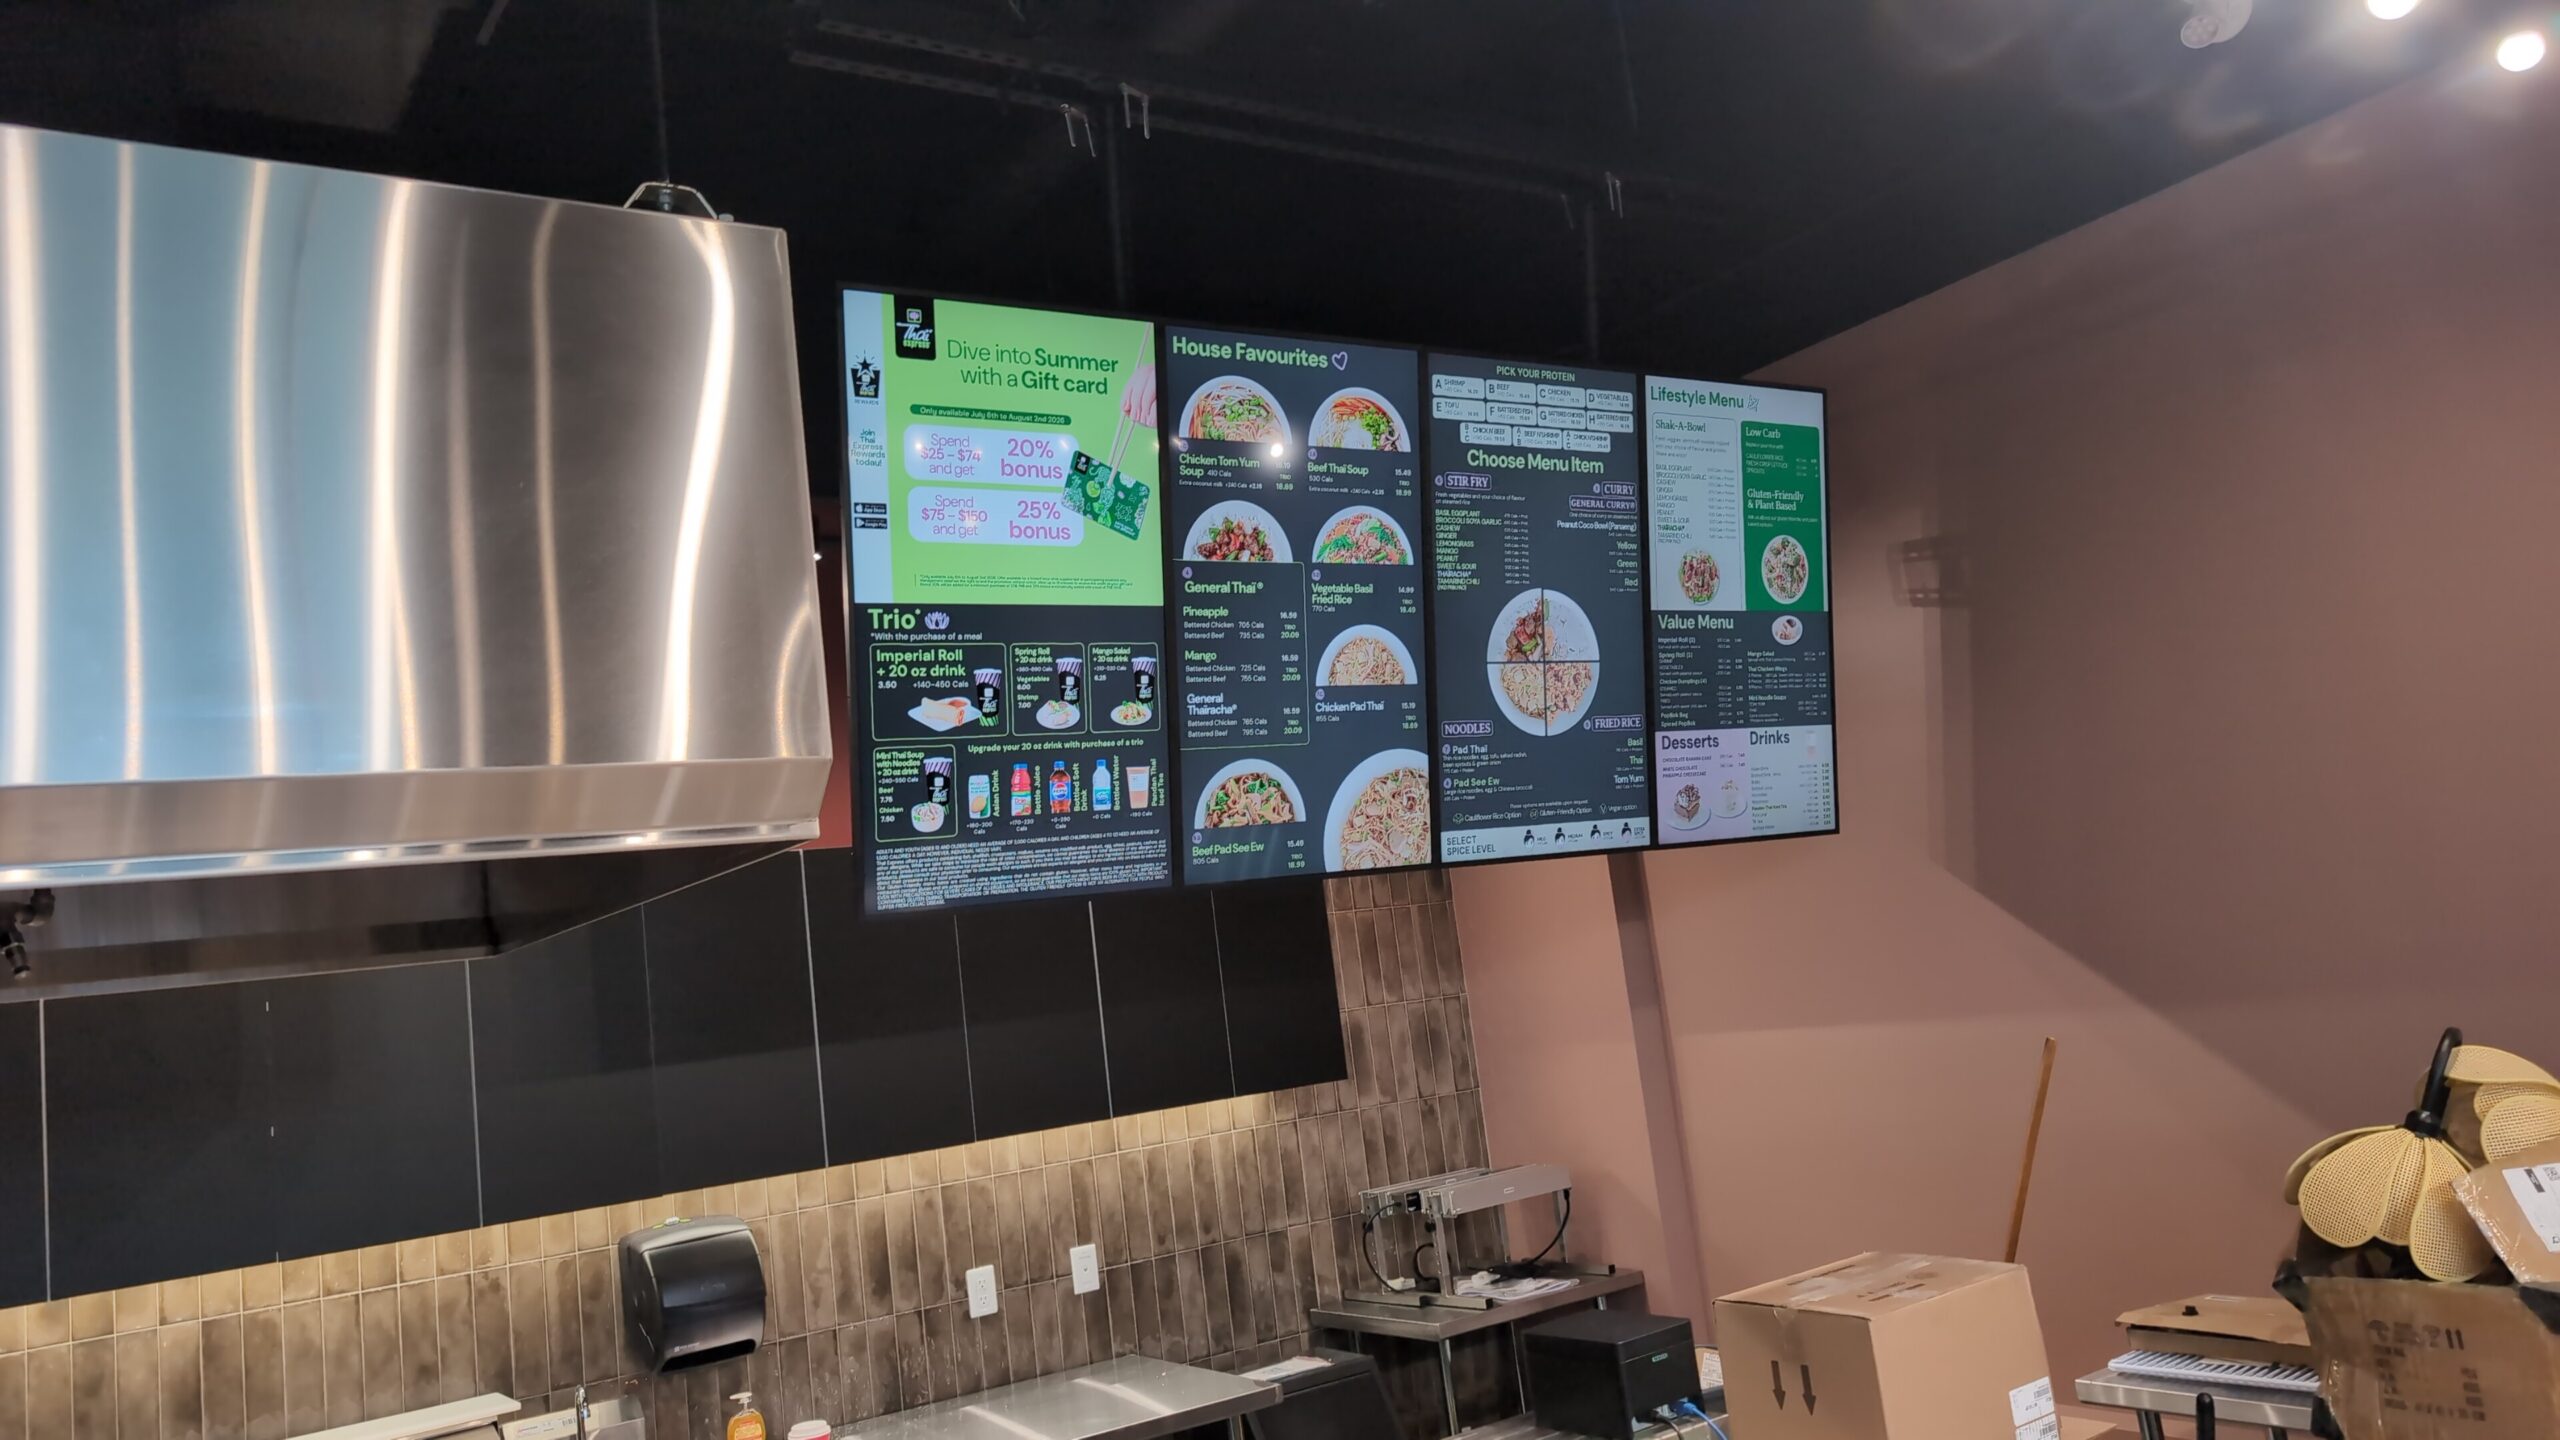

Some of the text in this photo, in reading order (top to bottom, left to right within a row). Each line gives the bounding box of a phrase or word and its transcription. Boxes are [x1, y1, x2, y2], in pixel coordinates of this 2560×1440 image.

[948, 340, 1118, 372] Dive into Summer
[1172, 335, 1328, 369] House Favourites
[1496, 365, 1576, 382] PICK YOUR PROTEIN
[960, 366, 1108, 395] with a Gift card
[1488, 383, 1495, 393] B
[1588, 393, 1629, 402] D VEGETABLES
[1650, 386, 1744, 409] Lifestyle Menu
[920, 406, 937, 416] Only
[938, 408, 970, 418] available
[970, 410, 986, 420] July
[1000, 413, 1008, 421] to
[1008, 414, 1033, 423] August
[1034, 416, 1048, 424] 2nd
[860, 428, 876, 436] Join
[1655, 419, 1706, 433] Shak-A-Bowl
[1745, 427, 1781, 439] Low Carb
[853, 442, 883, 450] Express
[931, 434, 970, 448] Spend
[850, 450, 886, 458] Rewards
[921, 447, 944, 460] $25
[957, 449, 981, 462] $74
[1007, 438, 1054, 459] 20%
[855, 459, 882, 467] today!
[1179, 453, 1260, 468] Chicken Tom Yum
[1467, 449, 1604, 474] Choose Menu Item
[929, 463, 975, 478] and get
[1001, 458, 1063, 479] bonus
[1308, 462, 1328, 472] Beef
[1347, 465, 1369, 477] Soup
[1447, 475, 1489, 488] STIR FRY
[1604, 484, 1634, 495] CURRY
[1747, 488, 1804, 503] Gluten-Friendly
[935, 495, 974, 510] Spend
[1571, 499, 1605, 508] GENERAL
[1747, 499, 1797, 511] & Plant Based
[922, 507, 945, 521] $75
[958, 509, 988, 522] $150
[1017, 501, 1061, 520] 25%
[933, 524, 978, 538] and get
[1009, 520, 1071, 541] bonus
[1616, 541, 1637, 550] Yellow
[1617, 559, 1638, 568] Green
[1184, 581, 1230, 594] General
[1624, 577, 1638, 586] Red
[1311, 583, 1373, 595] Vegetable Basil
[1312, 594, 1352, 604] Fried Rice
[1183, 606, 1229, 619] Pineapple
[1658, 614, 1734, 630] Value Menu
[895, 632, 909, 640] the
[910, 632, 946, 642] purchase
[947, 632, 956, 640] of
[964, 632, 982, 640] meal
[876, 649, 963, 664] Imperial Roll
[1015, 647, 1050, 656] Spring Roll
[1092, 647, 1131, 656] Mango Salad
[1184, 650, 1217, 663] Mango
[888, 665, 907, 677] 20
[911, 667, 927, 676] oz
[930, 664, 966, 676] drink
[1016, 675, 1050, 683] Vegetables
[1187, 693, 1223, 704] General
[1315, 701, 1350, 712] Chicken
[1350, 701, 1366, 711] Pad
[1444, 722, 1491, 735] NOODLES
[1594, 717, 1641, 729] FRIED RICE
[1627, 737, 1644, 747] Basil
[1661, 735, 1719, 750] Desserts
[1750, 731, 1790, 746] Drinks
[967, 744, 1001, 754] Upgrade
[1003, 744, 1019, 752] your
[1043, 741, 1062, 749] drink
[1081, 739, 1115, 750] purchase
[1116, 739, 1125, 747] of
[907, 751, 925, 760] Soup
[876, 760, 892, 768] with
[1453, 777, 1500, 788] Pad See Ew
[1614, 774, 1645, 784] Tom Yum
[991, 769, 999, 817] Asian Drink
[1446, 835, 1477, 846] SELECT
[1192, 841, 1265, 856] Beef Pad See Ew
[1446, 844, 1496, 857] SPICE LEVEL
